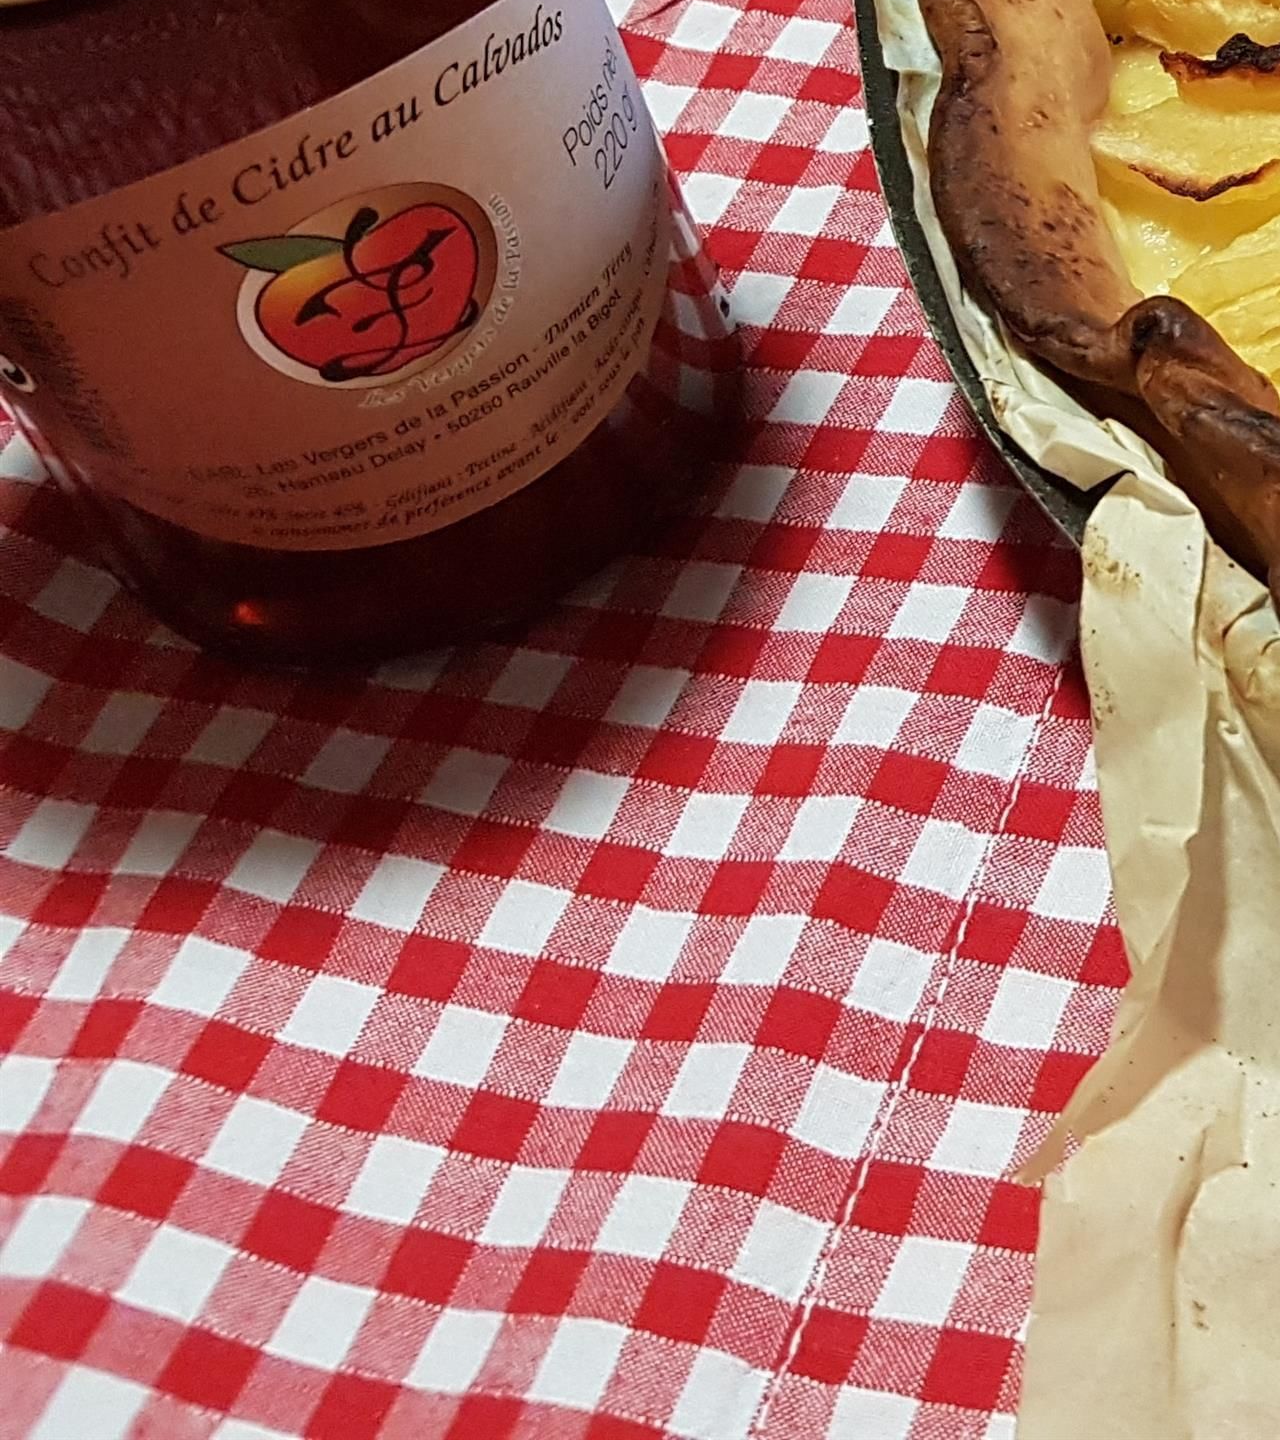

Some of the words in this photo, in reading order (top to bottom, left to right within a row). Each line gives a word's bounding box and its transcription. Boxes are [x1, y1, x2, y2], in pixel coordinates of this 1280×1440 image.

[29, 221, 161, 288] Confit
[171, 191, 224, 236] de
[231, 130, 360, 206] Cidre
[371, 95, 424, 143] au
[433, 4, 564, 108] Calvados
[562, 84, 608, 167] Poids
[595, 112, 628, 190] 220
[488, 194, 522, 264] Passion
[494, 294, 515, 323] de
[501, 269, 521, 290] la
[302, 429, 389, 468] Vergers
[395, 416, 422, 436] de
[426, 403, 449, 421] la
[450, 352, 531, 409] Passion
[544, 285, 600, 345] Damien
[447, 395, 504, 433] 50260
[506, 344, 571, 399] Rauville
[571, 329, 588, 348] la
[586, 288, 623, 331] Bigot
[496, 444, 543, 481] avant
